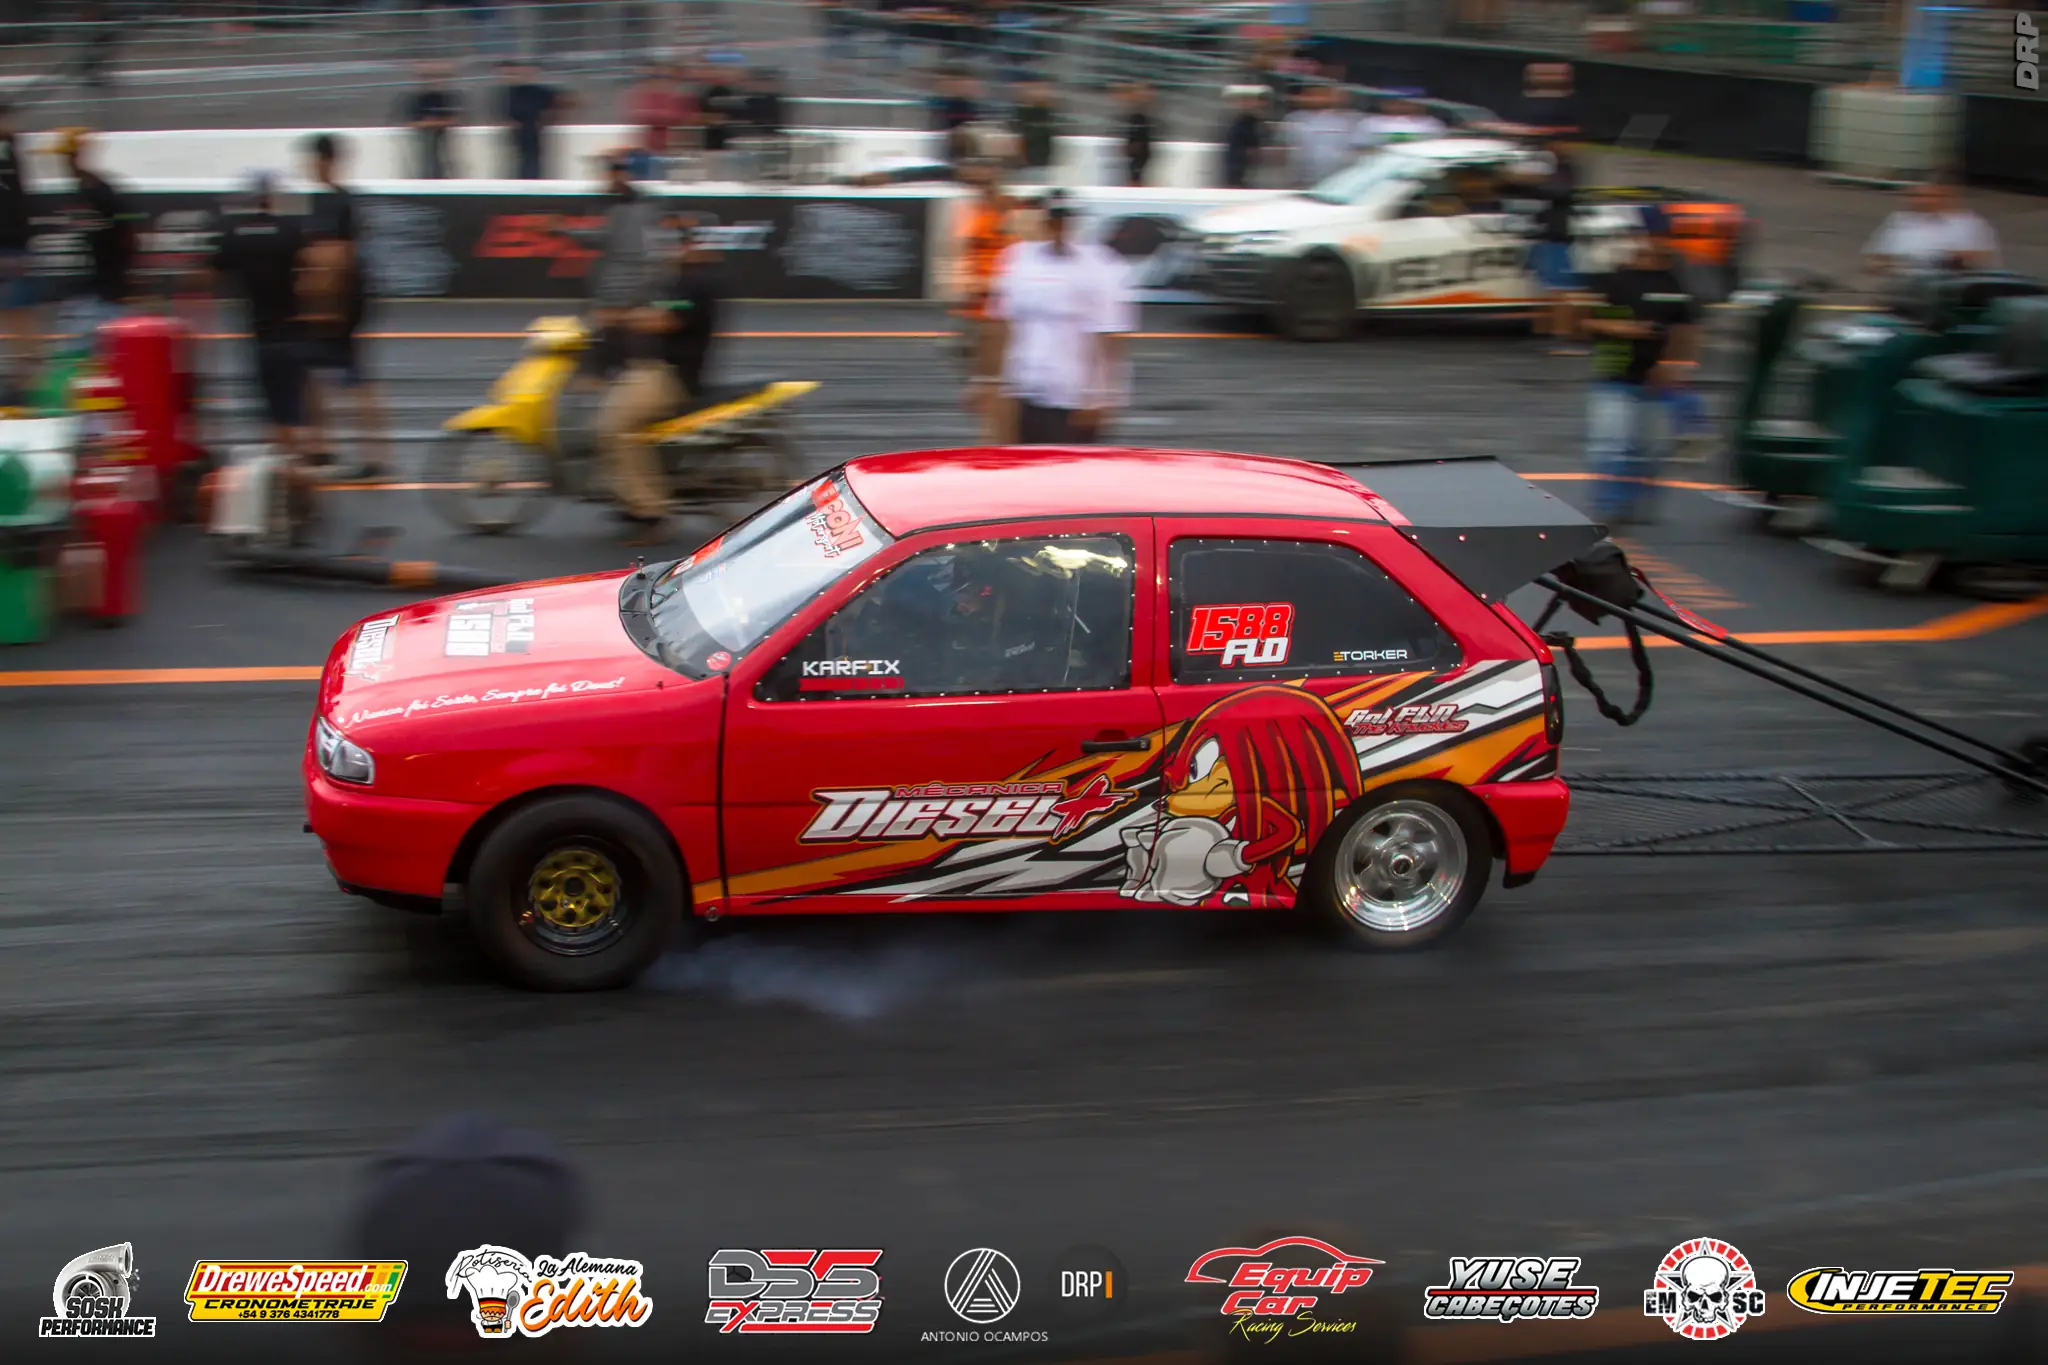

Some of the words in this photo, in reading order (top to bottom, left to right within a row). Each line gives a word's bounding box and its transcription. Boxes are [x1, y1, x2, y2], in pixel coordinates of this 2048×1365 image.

[1187, 604, 1292, 652] 1588
[1340, 649, 1408, 661] TORKER
[802, 660, 900, 676] KARFIX
